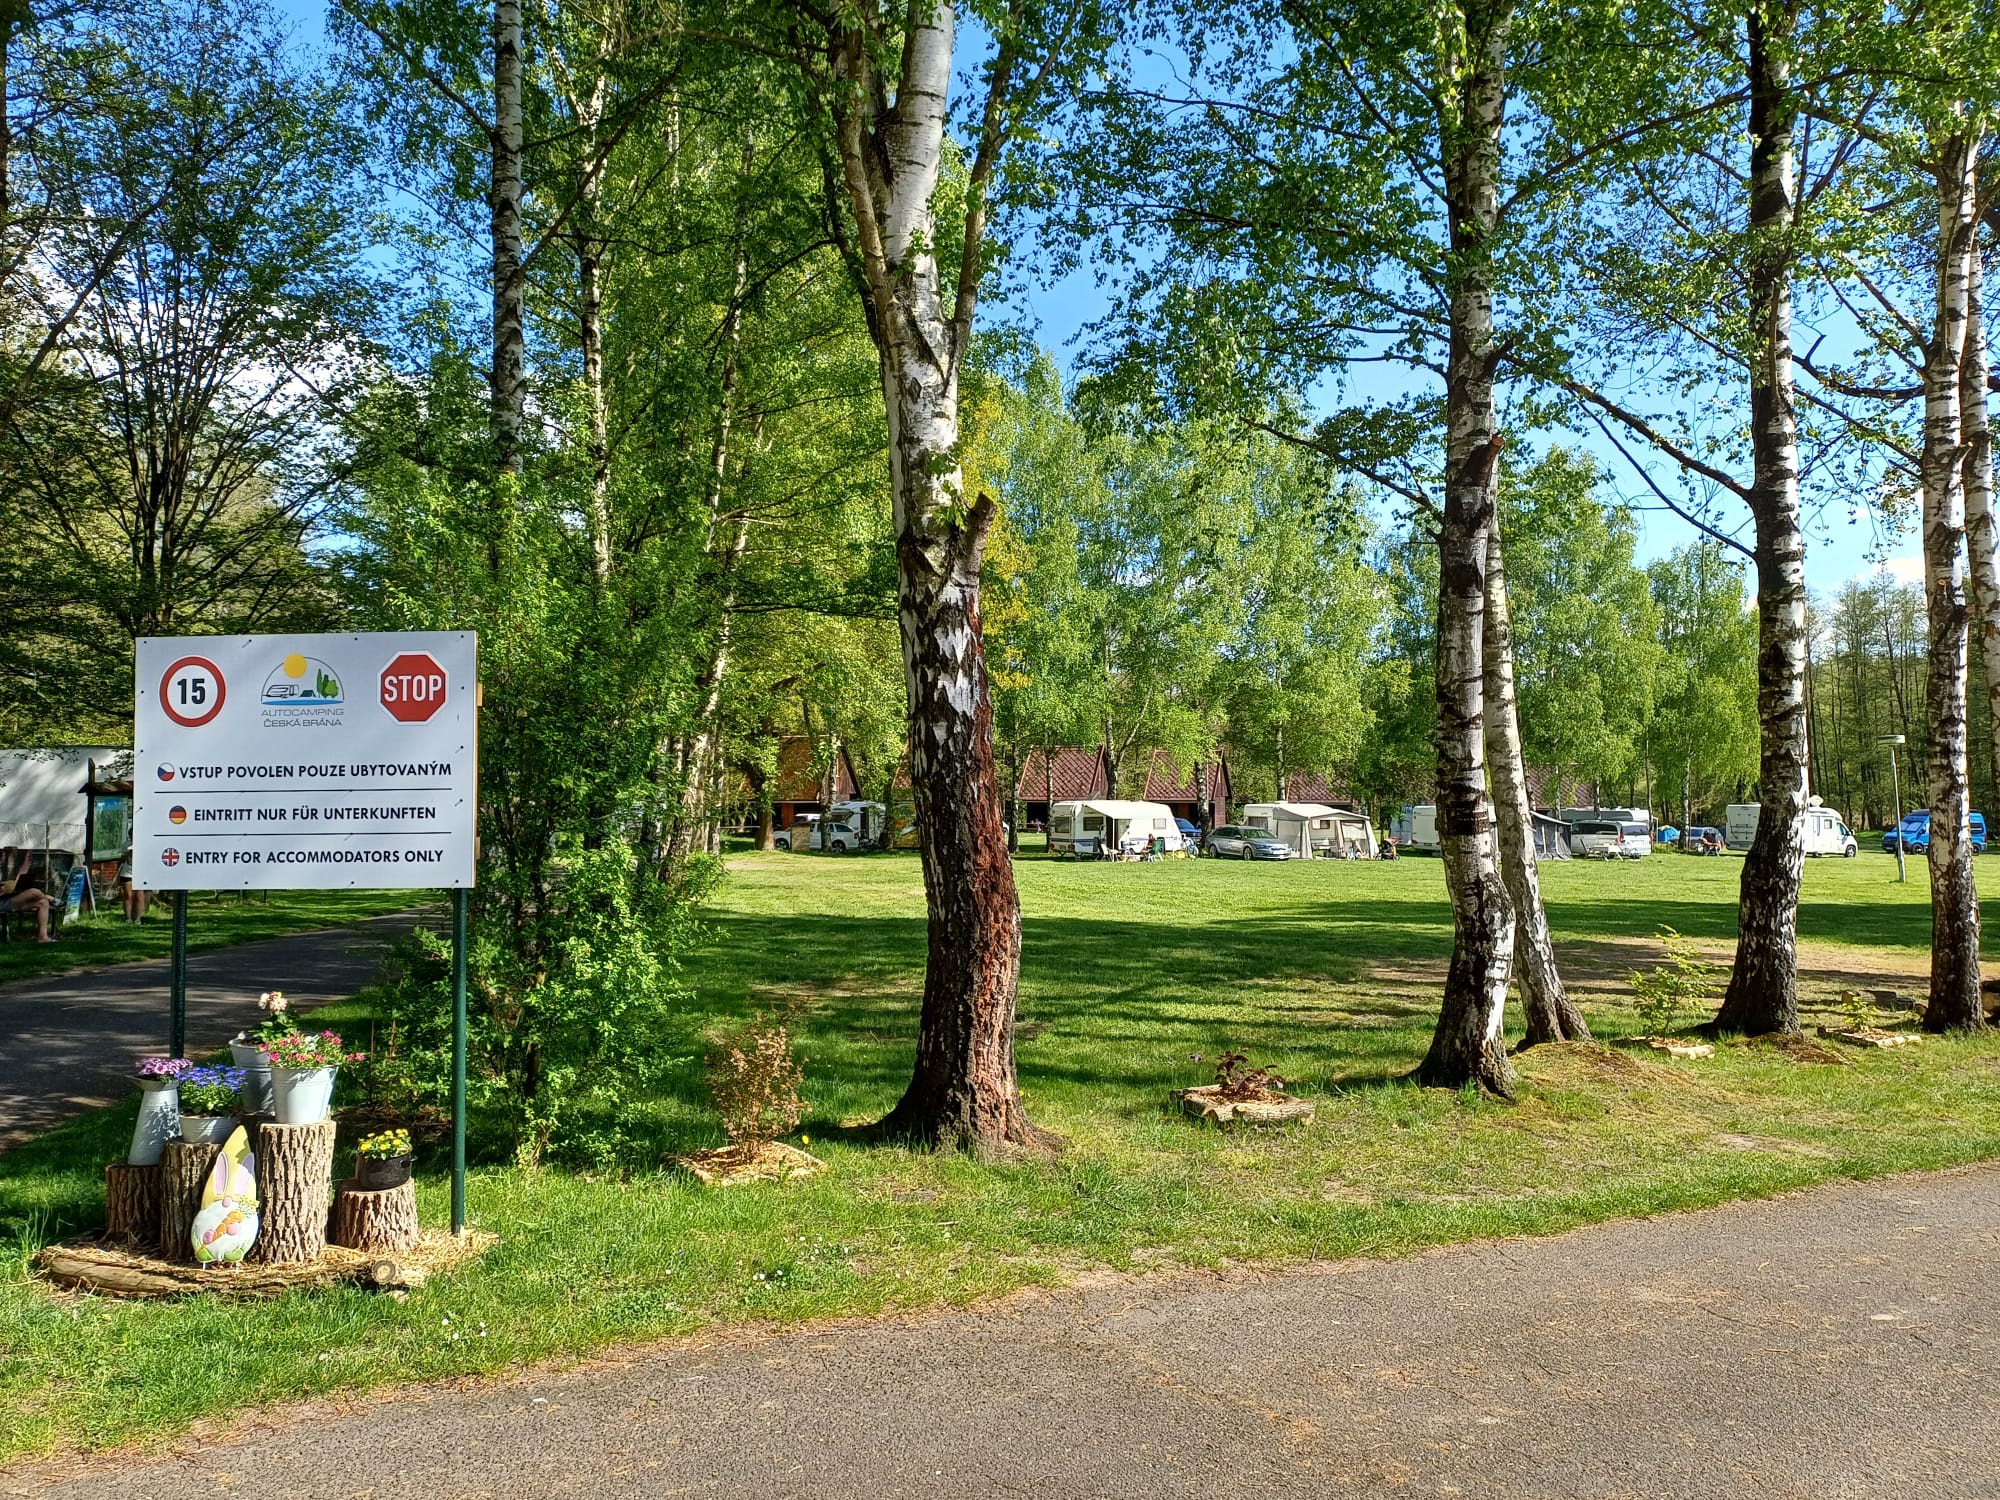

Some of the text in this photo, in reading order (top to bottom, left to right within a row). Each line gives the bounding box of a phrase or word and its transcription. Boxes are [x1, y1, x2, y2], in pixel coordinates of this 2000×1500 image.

[177, 678, 206, 705] 15
[384, 674, 443, 702] STOP
[261, 708, 345, 717] AUTOCAMPING
[263, 718, 343, 728] ČESKÁ BRÁNA
[179, 760, 452, 779] VSTUP POVOLEN POUZE UBYTOVANÝM
[194, 804, 436, 822] EINTRITT NUR FÜR UNTERKUNFTEN
[185, 849, 444, 865] ENTRY FOR ACCOMMODATORS ONLY
